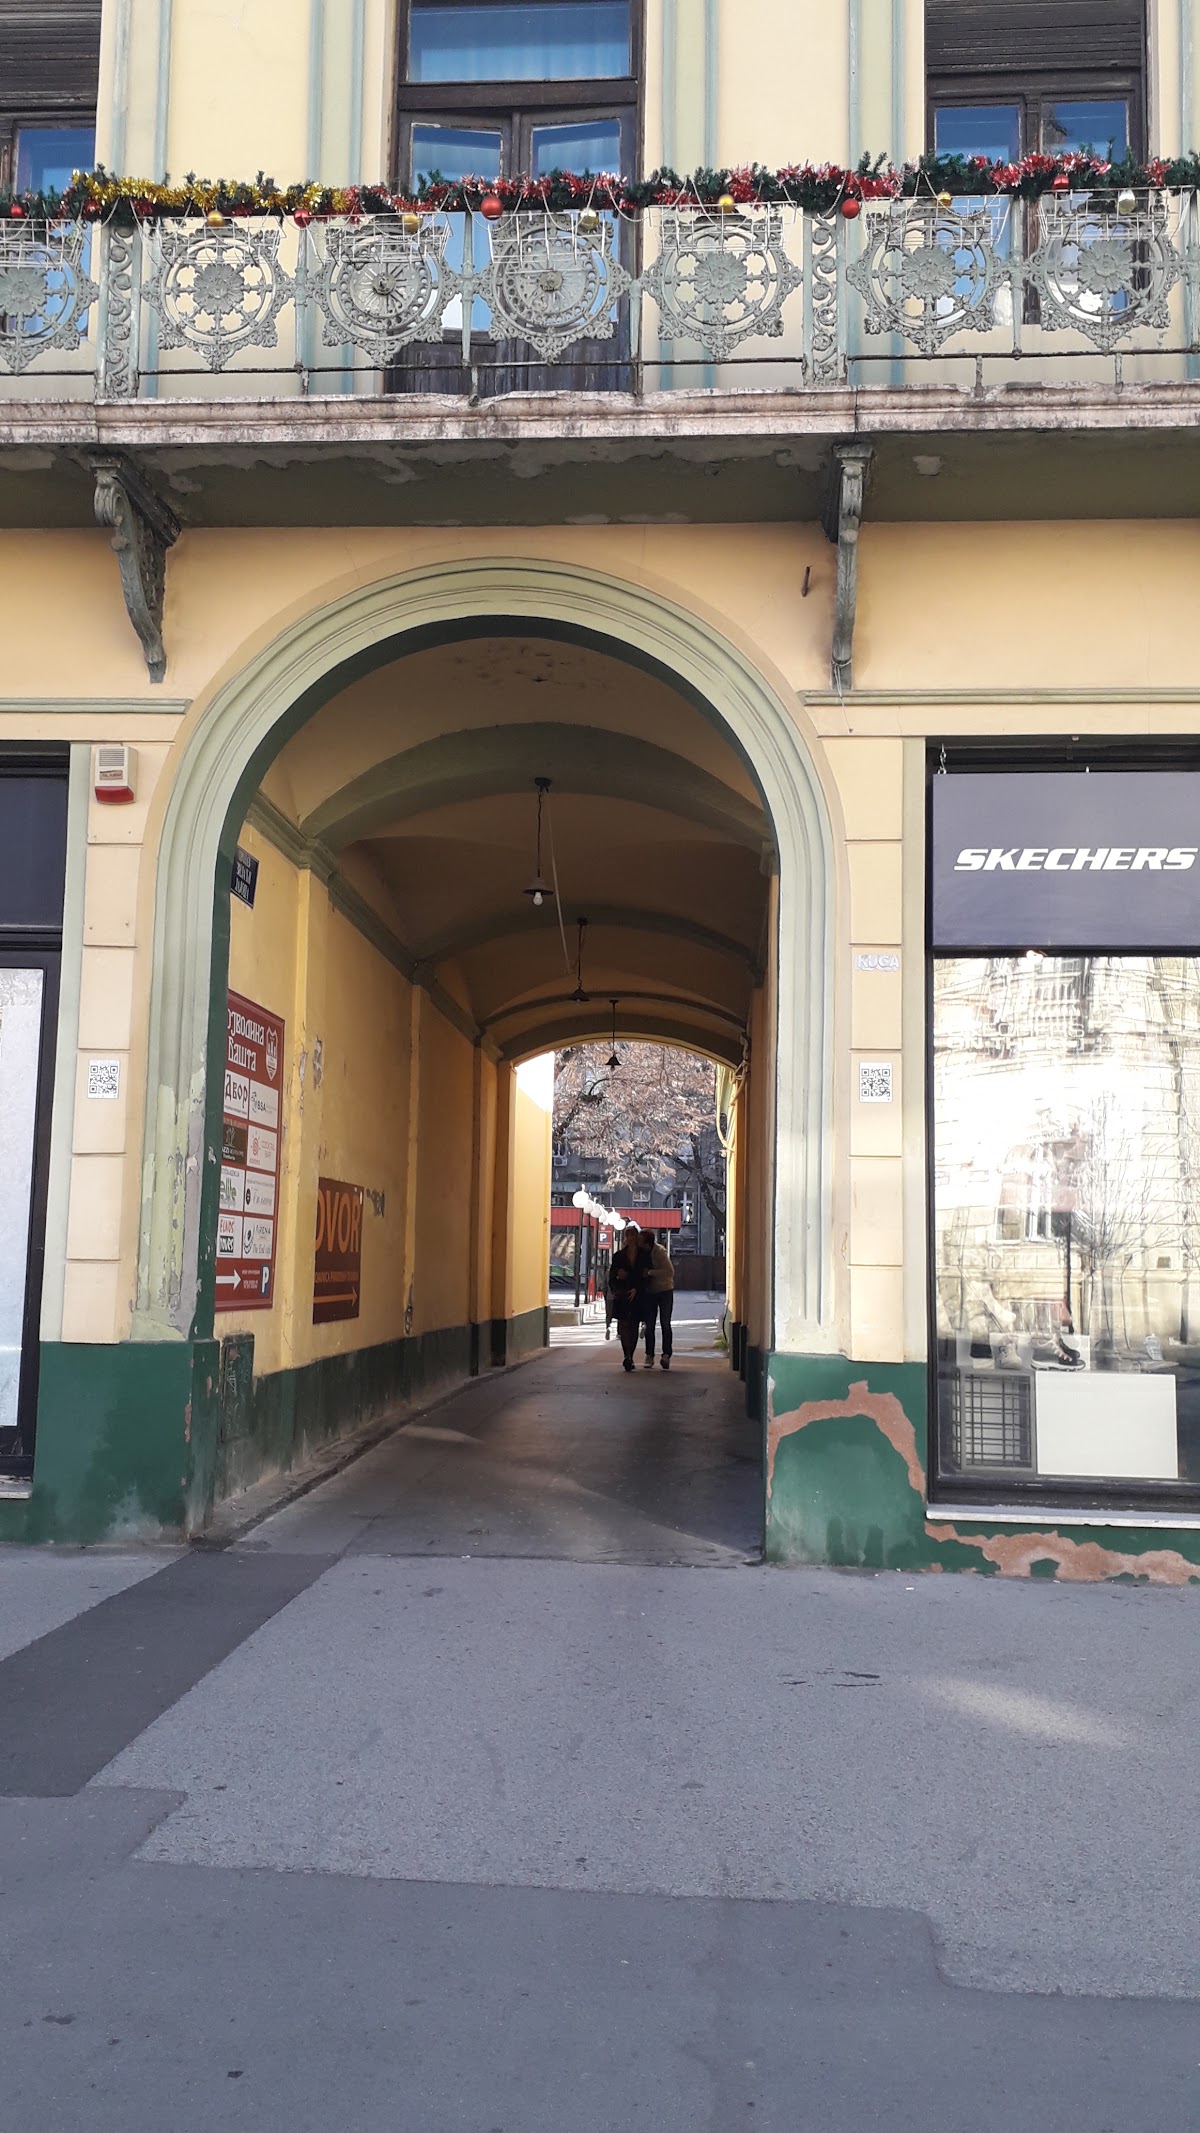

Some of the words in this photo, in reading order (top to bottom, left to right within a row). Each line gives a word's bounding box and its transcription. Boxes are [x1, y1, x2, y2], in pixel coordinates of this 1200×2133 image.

[953, 848, 1199, 871] SKECHERS
[600, 1233, 607, 1242] P
[262, 1266, 269, 1293] P
